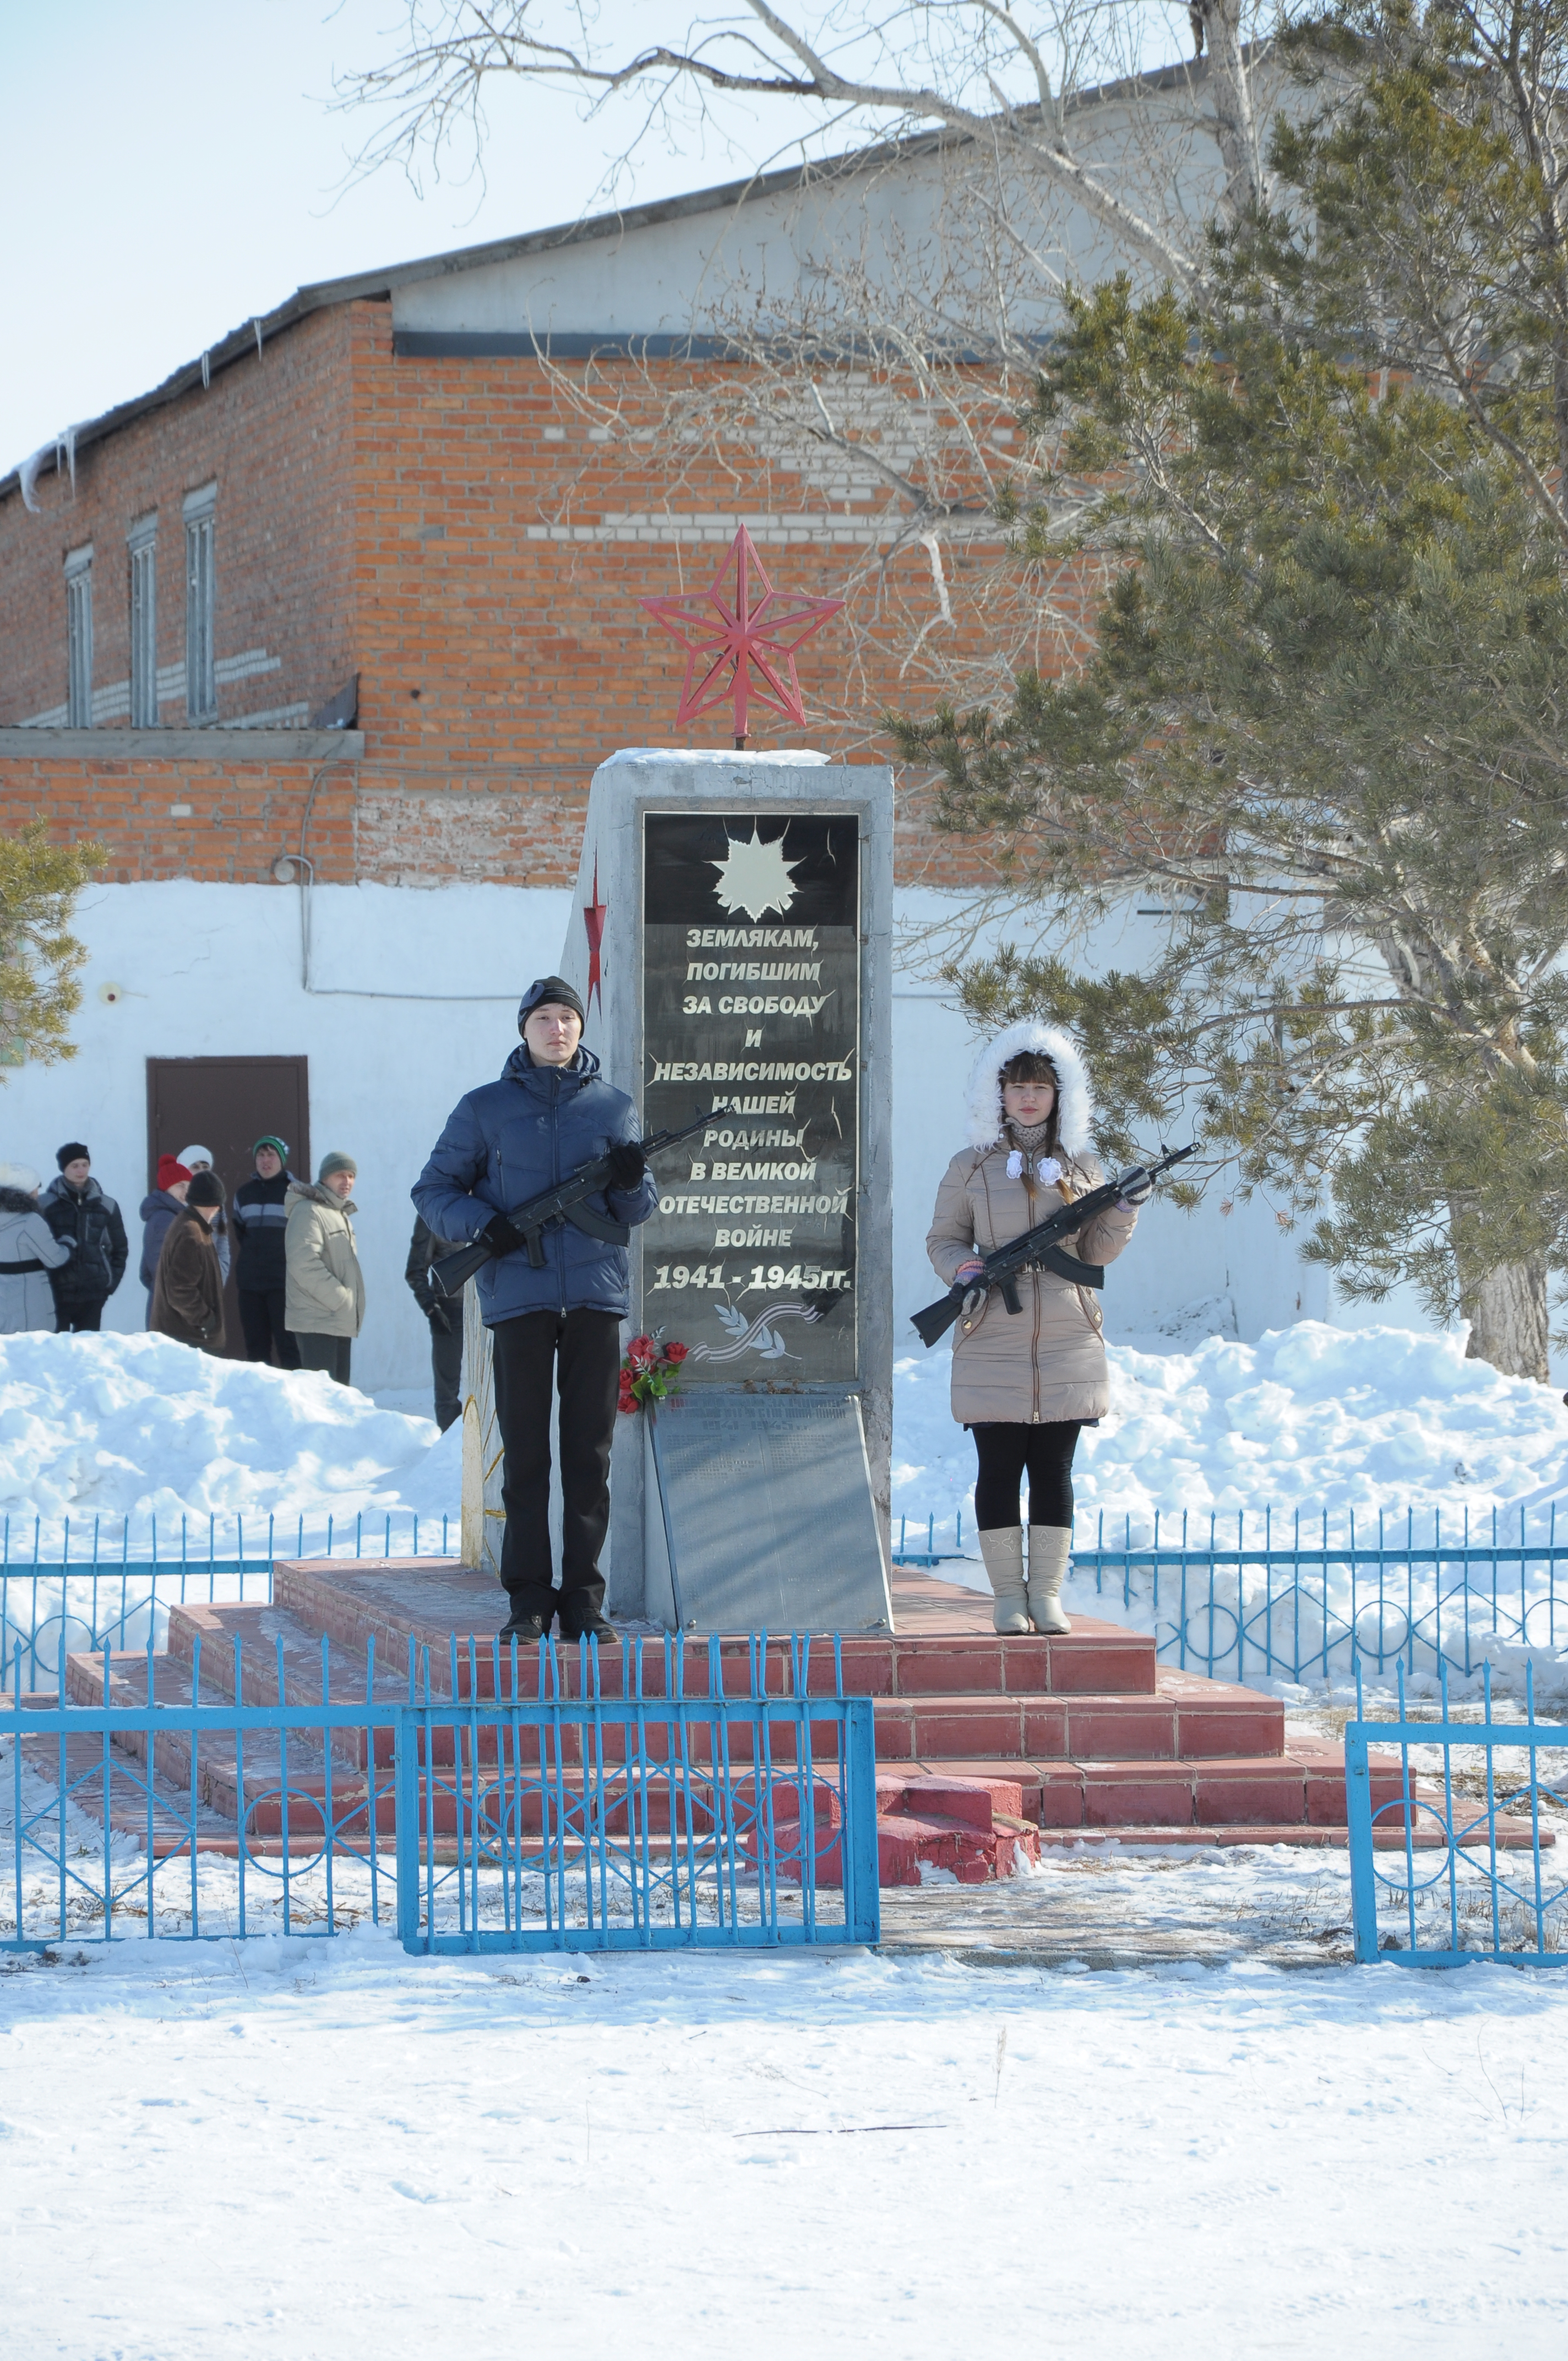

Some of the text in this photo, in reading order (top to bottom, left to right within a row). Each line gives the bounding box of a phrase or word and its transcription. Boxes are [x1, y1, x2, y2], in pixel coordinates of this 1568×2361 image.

[687, 929, 819, 951] ЗЕМЛЯКАМ,
[687, 962, 820, 981] ПОГИБШИМ
[683, 995, 826, 1018] ЗА СВОБОДУ
[745, 1029, 762, 1047] И
[654, 1062, 852, 1081] НЕЗАВИСИМОСТЬ
[711, 1091, 796, 1114] НАШЕЙ
[703, 1129, 804, 1150] РОДИНЫ
[690, 1156, 817, 1180] В ВЕЛИКОЙ
[659, 1188, 850, 1214] ОТЕЧЕСТВЕННОЙ
[715, 1224, 793, 1247] ВОЙНЕ
[654, 1265, 725, 1289] 1941
